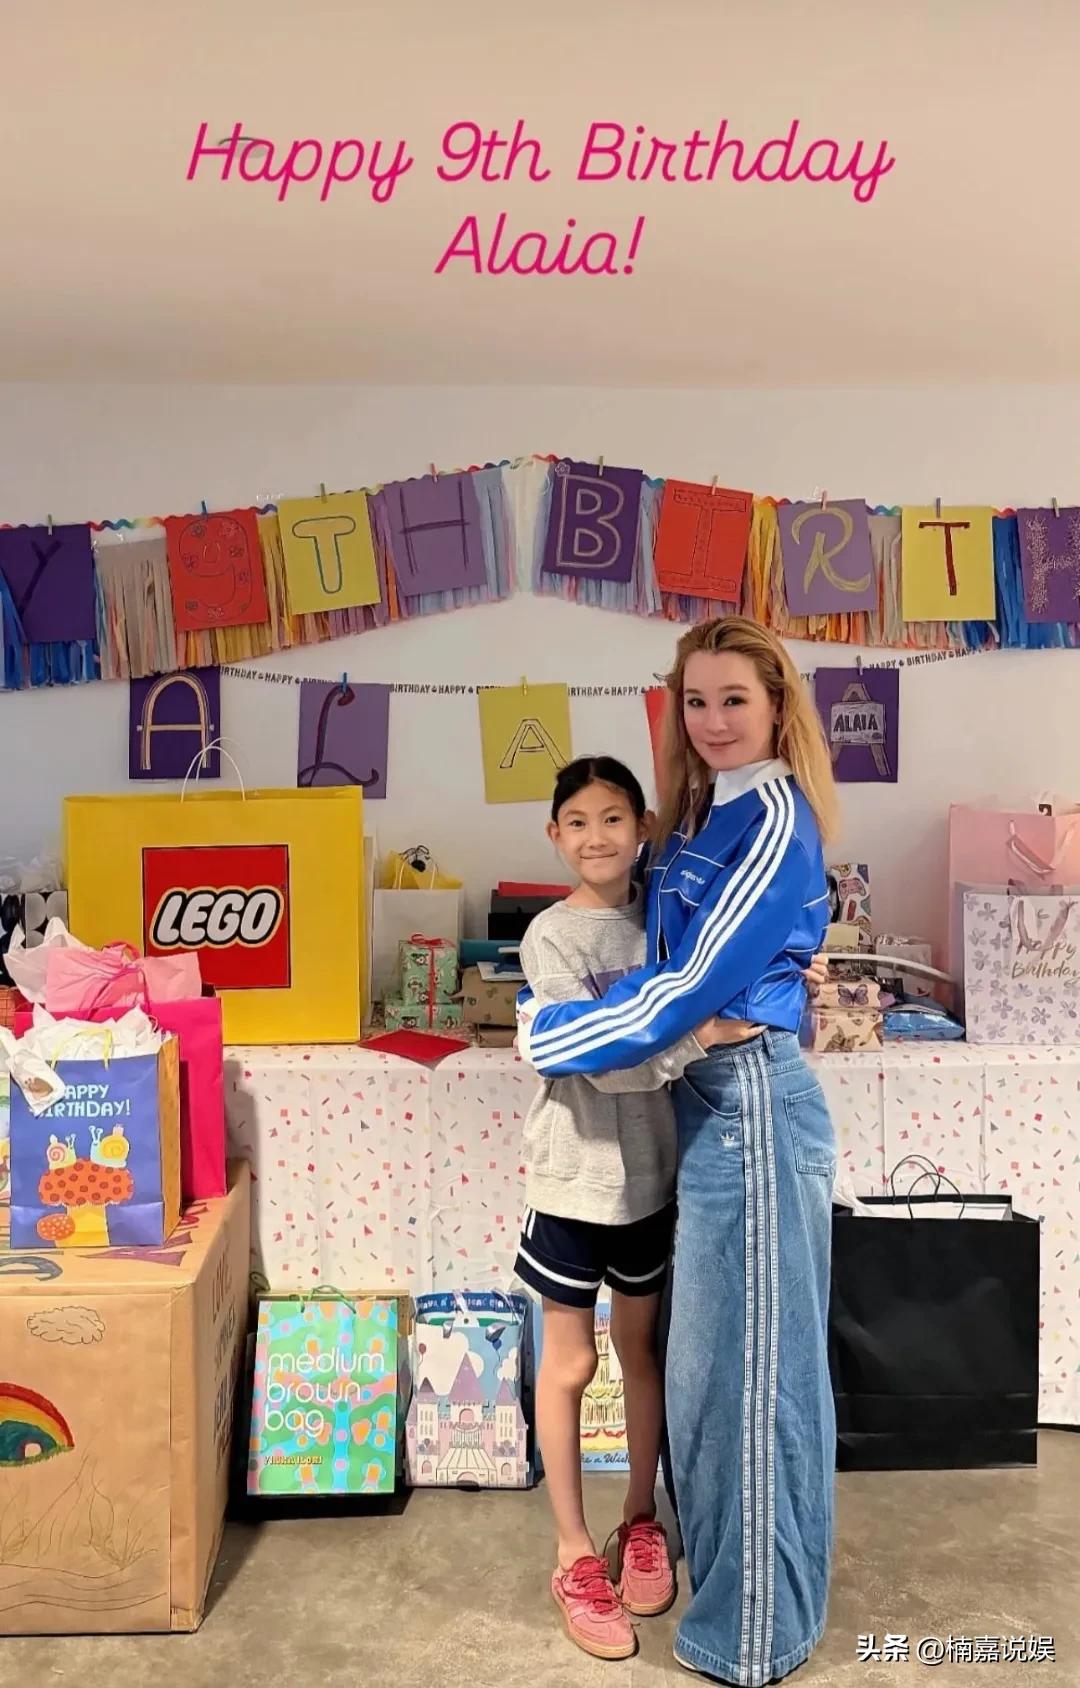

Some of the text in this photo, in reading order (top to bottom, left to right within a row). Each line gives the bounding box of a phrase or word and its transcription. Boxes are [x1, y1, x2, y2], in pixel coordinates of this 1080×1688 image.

[220, 666, 257, 680] IRTHDAY
[265, 672, 293, 684] HAPPY
[438, 685, 465, 694] HAPPY
[568, 686, 603, 697] IRTHDAY
[611, 686, 638, 696] HAPPY
[906, 652, 947, 667] BIRTHDAY
[833, 713, 878, 732] ALAIA
[151, 887, 284, 947] LEGO
[65, 1085, 109, 1099] APPY
[42, 1099, 130, 1117] IRTHDAY!
[267, 1347, 384, 1374] medium
[266, 1378, 361, 1403] brown
[264, 1404, 325, 1437] bag
